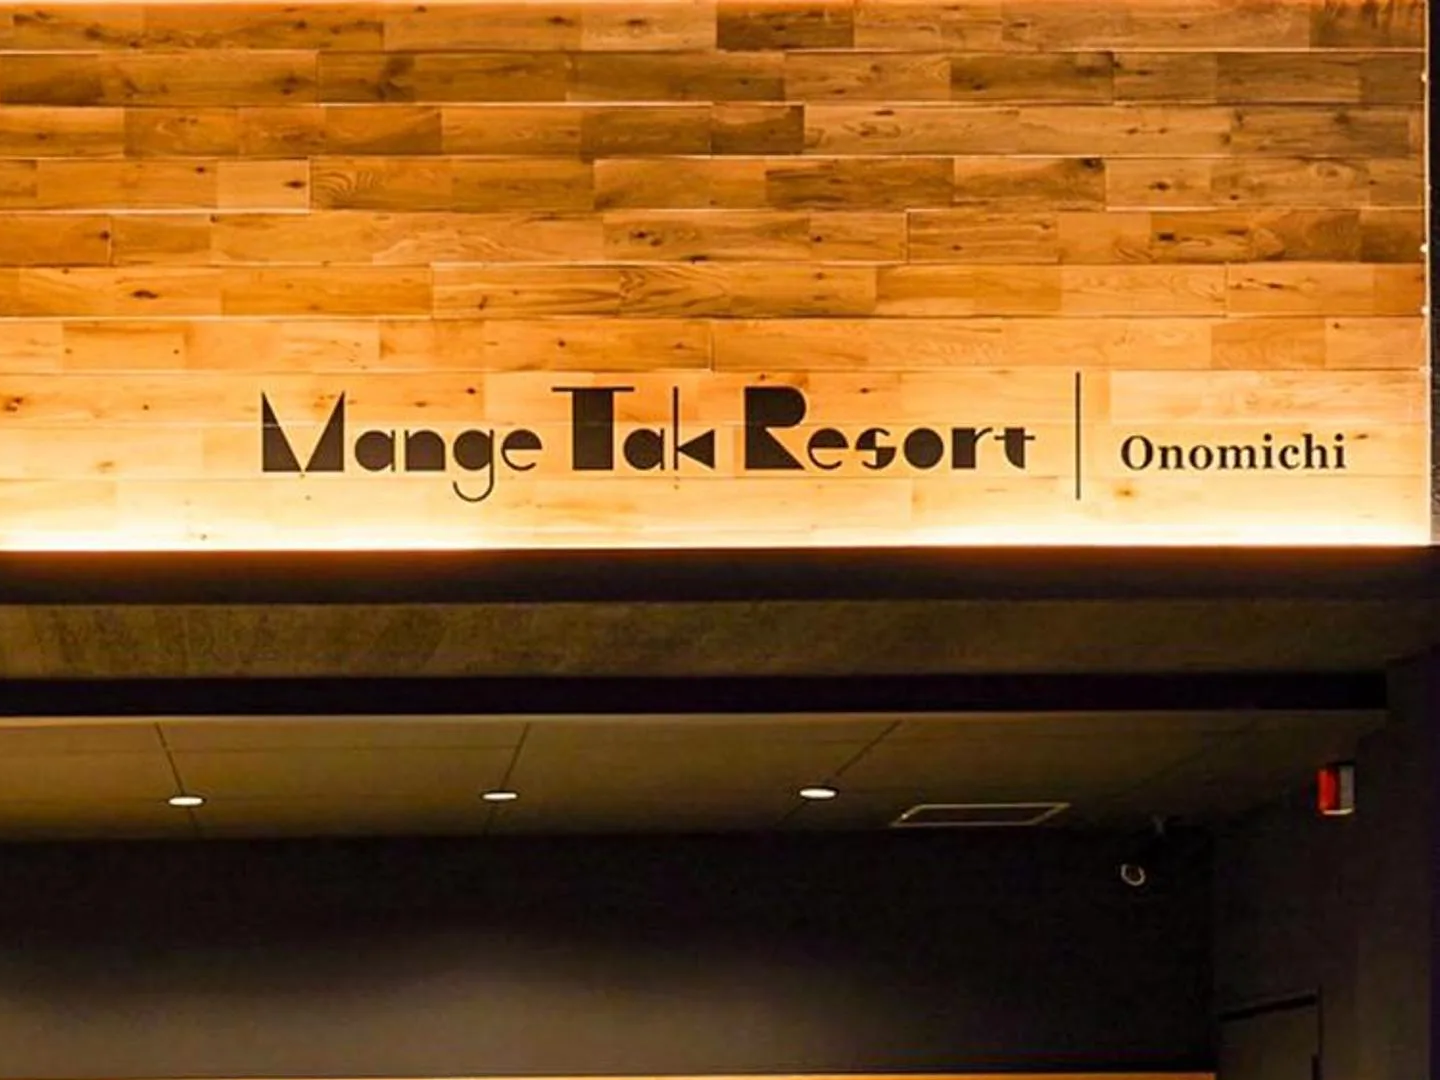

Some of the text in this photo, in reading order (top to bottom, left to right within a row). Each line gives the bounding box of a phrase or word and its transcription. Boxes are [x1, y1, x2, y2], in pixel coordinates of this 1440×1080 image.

[260, 385, 1347, 502] Mange Tak Resort Onomichi
